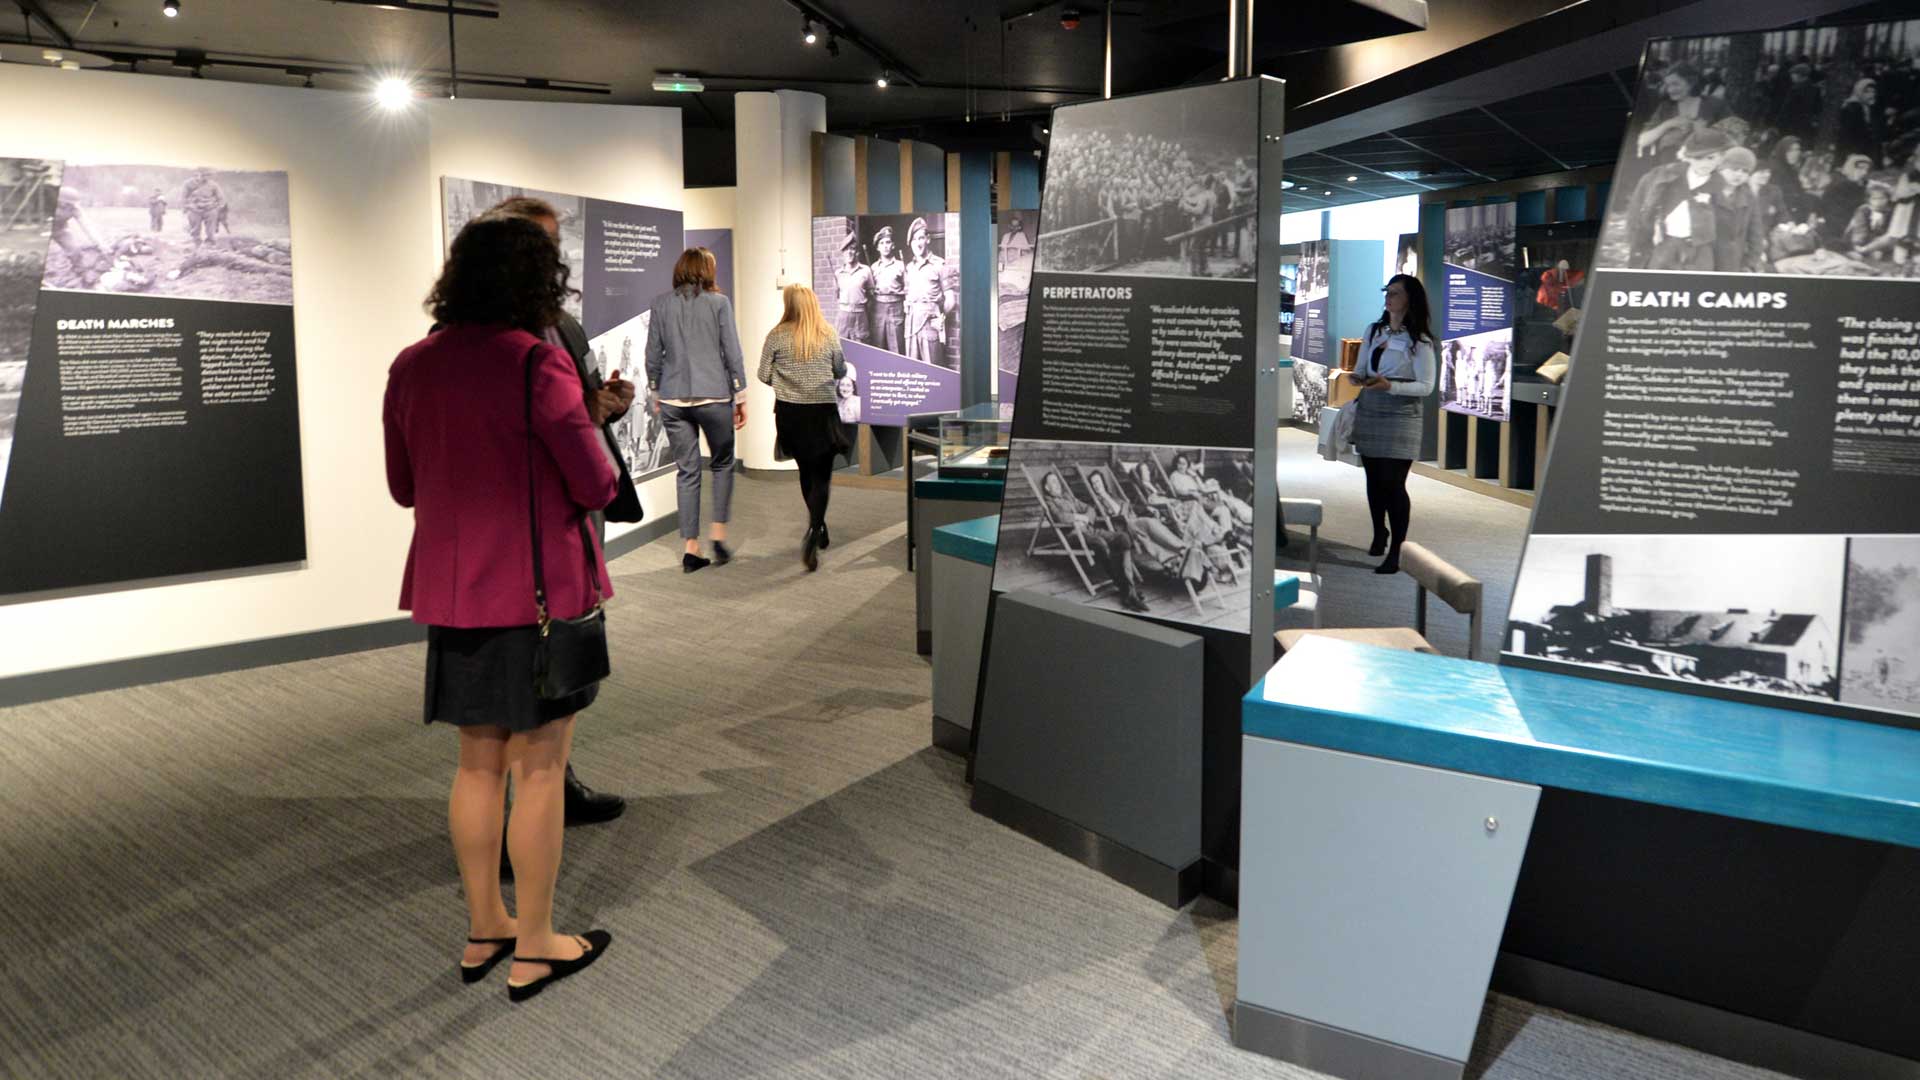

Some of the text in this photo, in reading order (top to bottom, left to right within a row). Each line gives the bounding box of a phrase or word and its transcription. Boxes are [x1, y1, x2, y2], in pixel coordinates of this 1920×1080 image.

[1042, 286, 1132, 300] PERPETRATORS
[1610, 291, 1788, 309] DEATH CAMPS
[57, 318, 175, 330] DEATH MARCHES
[1868, 317, 1913, 333] closing
[1841, 332, 1918, 348] was finished
[1840, 348, 1865, 359] had
[1866, 348, 1889, 360] the
[1838, 362, 1868, 377] they
[1869, 364, 1899, 376] took
[1838, 378, 1864, 390] and
[1864, 380, 1908, 393] gassed
[1837, 392, 1920, 408] them in mass
[1835, 408, 1876, 425] plenty
[1877, 410, 1912, 423] other
